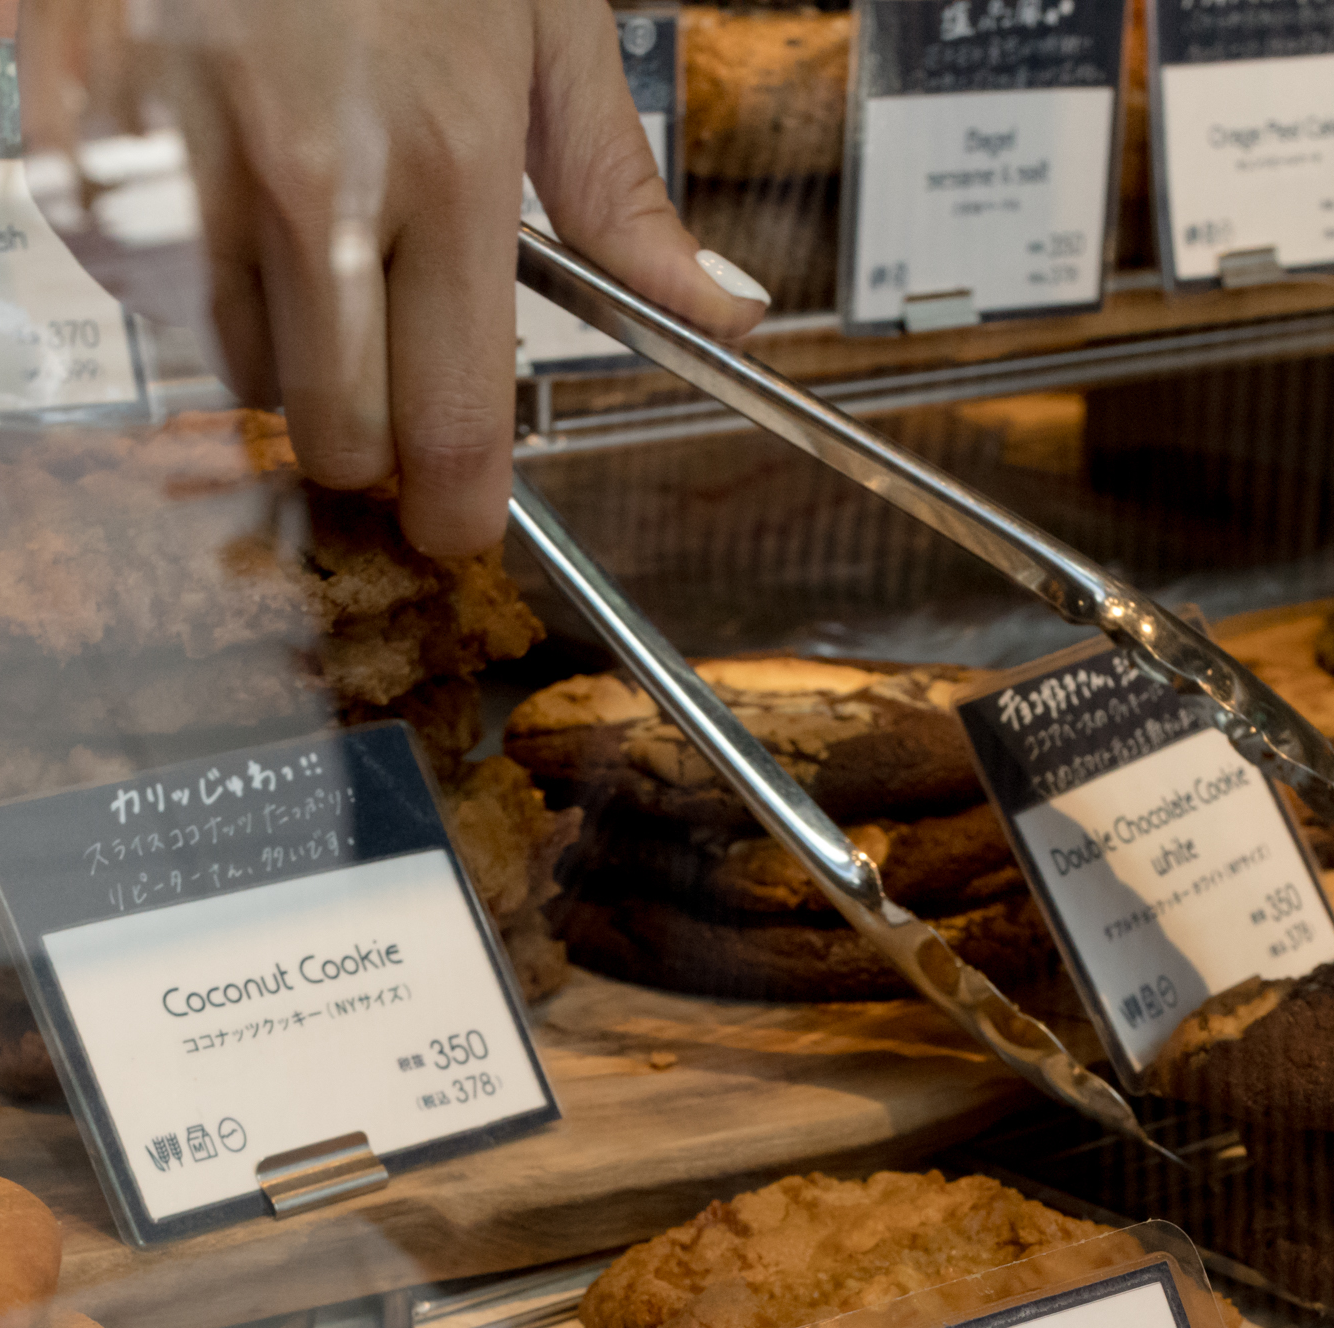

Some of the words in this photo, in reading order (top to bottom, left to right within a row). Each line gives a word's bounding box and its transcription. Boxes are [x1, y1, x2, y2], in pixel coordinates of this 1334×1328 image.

[1051, 822, 1117, 876] Double
[1114, 787, 1198, 845] Chocolate
[1194, 765, 1251, 809] Cookie
[1150, 835, 1200, 876] white
[1266, 882, 1303, 922] 350
[162, 963, 291, 1018] Coconut
[300, 940, 404, 986] Cookie
[430, 1030, 489, 1070] 350
